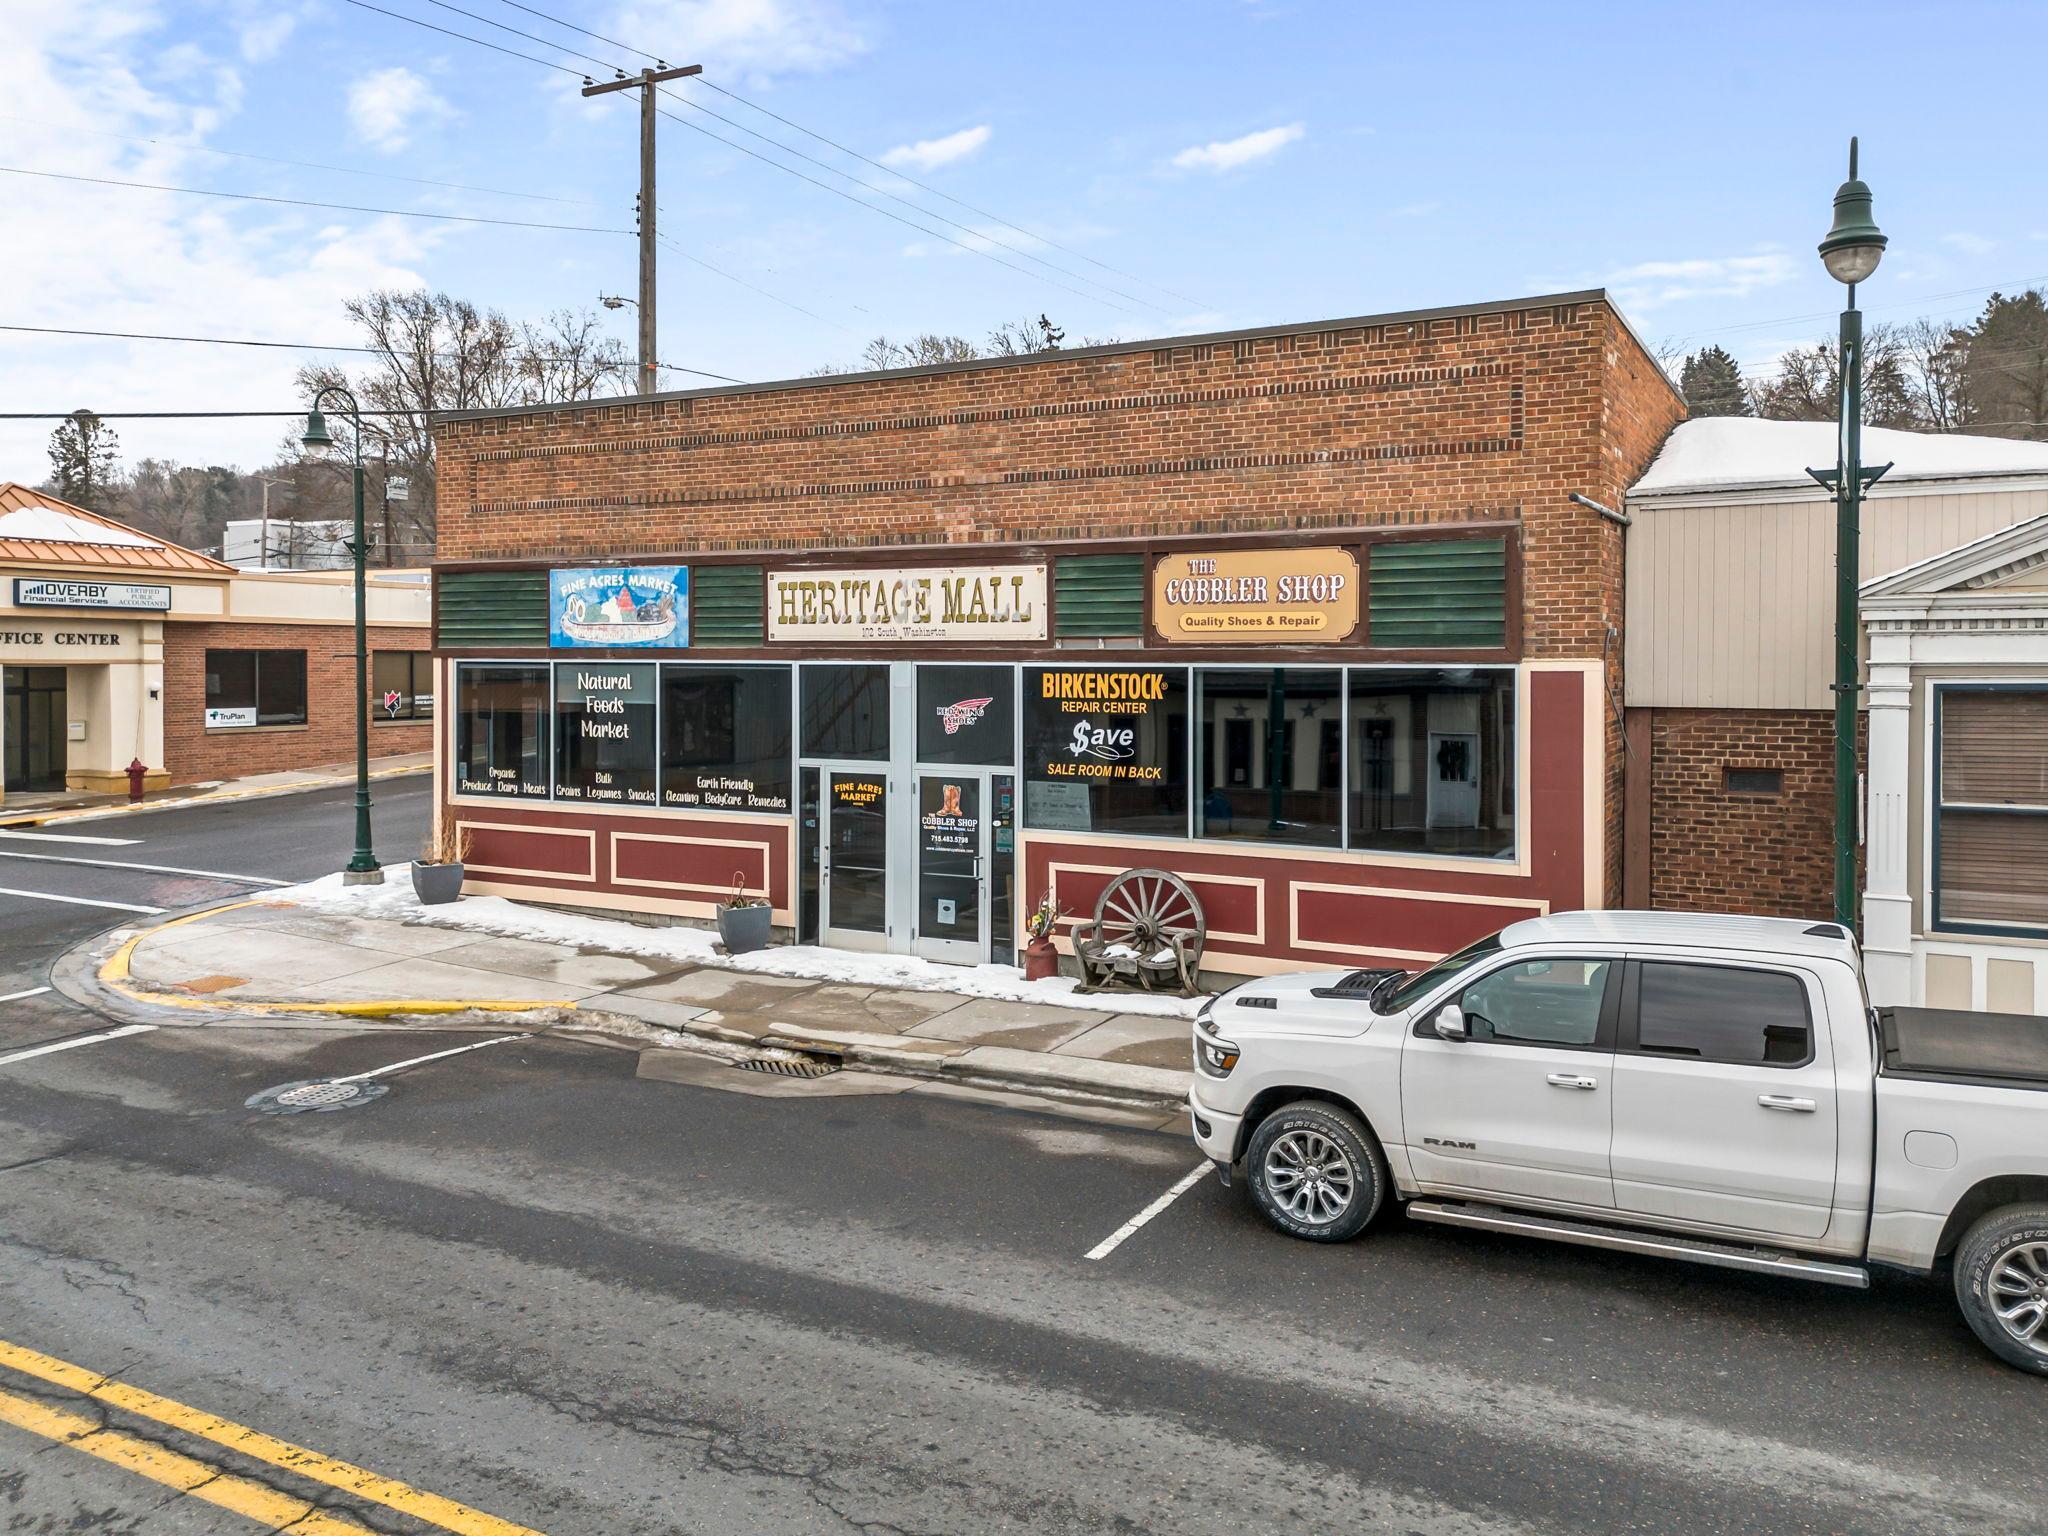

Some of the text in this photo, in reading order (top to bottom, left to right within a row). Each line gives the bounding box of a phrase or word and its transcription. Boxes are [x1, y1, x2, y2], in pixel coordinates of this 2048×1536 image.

[1188, 559, 1217, 576] THE
[45, 583, 108, 597] OVERBY
[126, 587, 160, 595] CERTIFIED
[560, 574, 678, 597] FINE ACRES MARKET
[1165, 573, 1345, 605] COBBLER SHOP
[23, 595, 109, 605] Financial Services
[119, 599, 168, 608] ACCOUNTANTS
[777, 576, 1032, 625] HERITAGE MALL
[1185, 615, 1321, 628] Quality Shoes & Repair
[54, 633, 121, 646] CENTER
[577, 672, 633, 690] Natural
[585, 695, 625, 714] Foods
[1061, 701, 1148, 714] REPAIR CENTER
[219, 713, 246, 721] TruPlan
[581, 719, 630, 739] Market
[1069, 719, 1134, 757] $ave
[489, 766, 517, 780] Organic
[595, 772, 613, 784] Bulk
[1047, 763, 1162, 779] SALE ROOM IN BACK
[462, 779, 546, 795] Produce Dairy Meats
[697, 776, 754, 793] Earth Friendly
[834, 782, 882, 795] FINE ACRES
[556, 784, 656, 802] Grains Legumes Snacks
[665, 789, 700, 804] Cleaning
[748, 793, 787, 808] Remedies
[840, 792, 876, 802] MARKET
[922, 816, 978, 827] COBBLER SHOP
[1283, 1120, 1363, 1182] BRIDGESTONE
[1423, 1137, 1476, 1150] RAM
